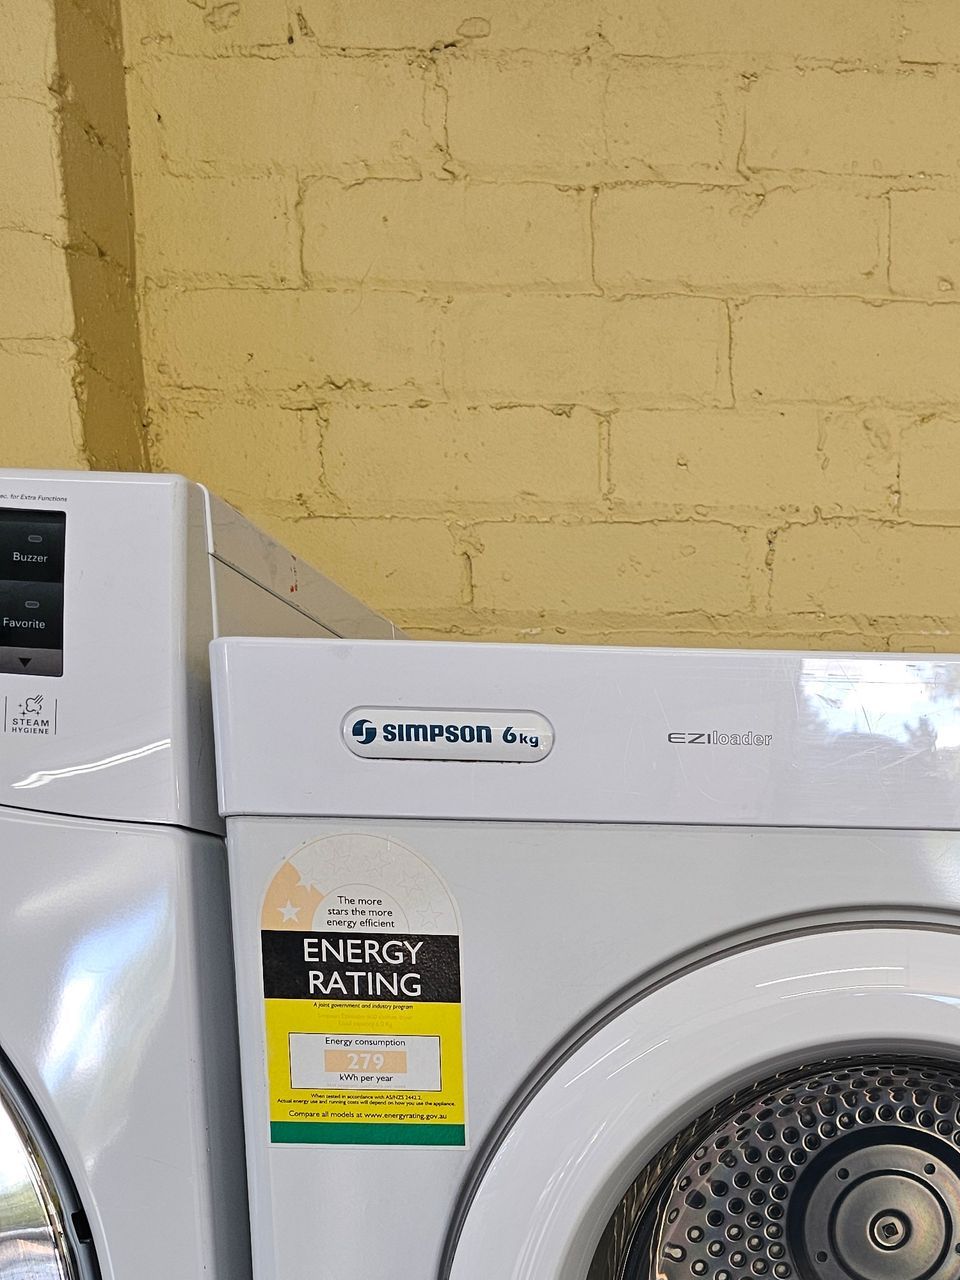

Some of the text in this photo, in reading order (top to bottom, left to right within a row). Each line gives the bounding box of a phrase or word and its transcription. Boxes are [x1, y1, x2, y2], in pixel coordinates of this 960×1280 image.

[13, 552, 48, 562] Buzzer
[3, 618, 46, 629] Favorite
[12, 718, 49, 728] STEAM
[12, 727, 49, 735] HYGIENE
[382, 724, 492, 744] SIMPSON
[337, 896, 355, 905] The
[328, 908, 348, 916] stars
[351, 908, 366, 916] the
[327, 919, 395, 929] energy efficient
[303, 938, 424, 964] ENERGY
[308, 970, 421, 997] RATING
[325, 1037, 406, 1047] Energy consumption
[347, 1053, 384, 1070] 279
[288, 1110, 320, 1118] Compare
